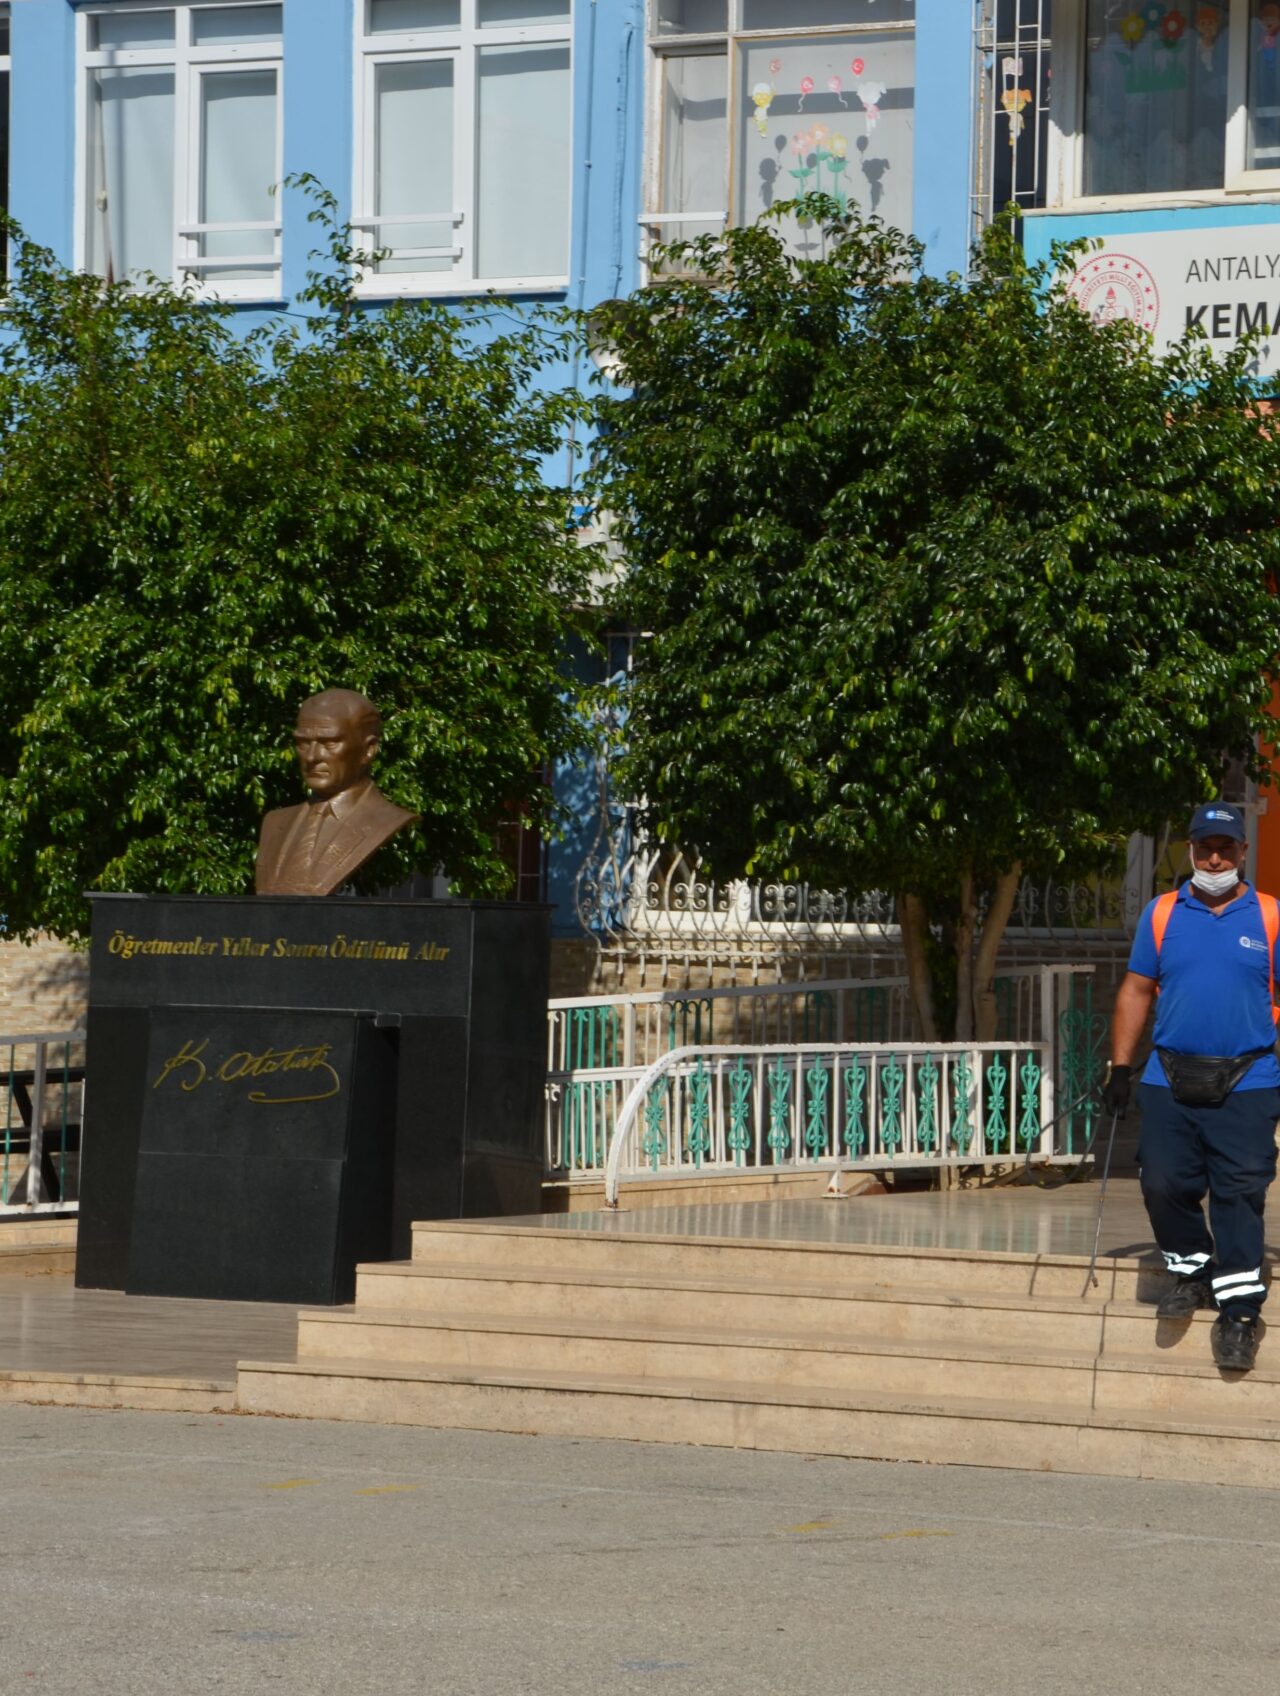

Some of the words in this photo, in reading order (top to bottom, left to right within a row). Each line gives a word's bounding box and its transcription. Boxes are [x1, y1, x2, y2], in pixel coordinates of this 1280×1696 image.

[108, 930, 218, 959] Öğretmenler
[222, 937, 270, 957] Yıllar
[330, 934, 410, 960] Ödülünü
[413, 941, 451, 961] Alır
